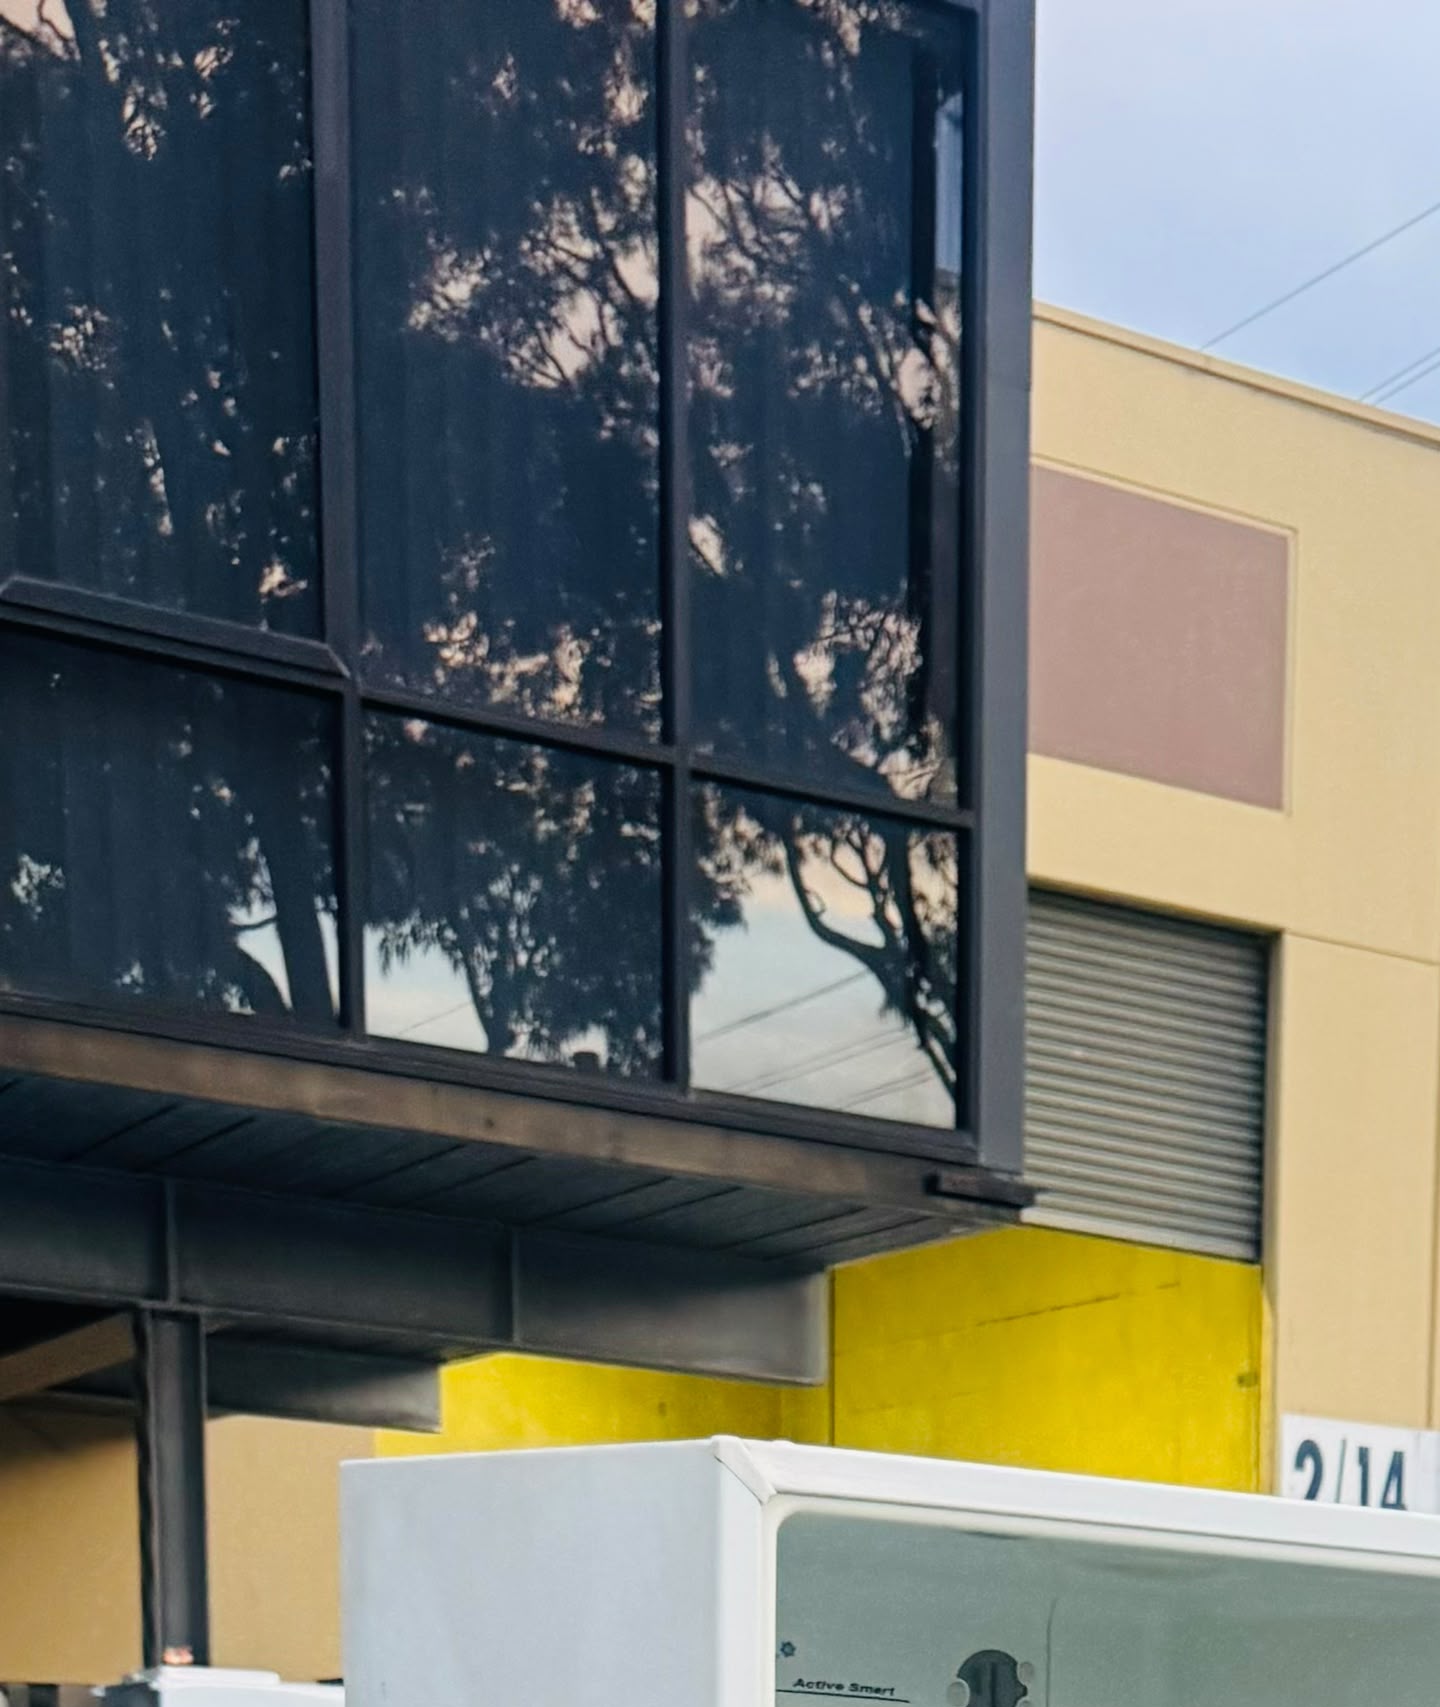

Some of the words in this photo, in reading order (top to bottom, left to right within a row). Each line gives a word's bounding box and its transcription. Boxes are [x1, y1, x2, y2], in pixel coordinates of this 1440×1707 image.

[1294, 1438, 1407, 1511] 2/14
[792, 1677, 845, 1691] Active
[848, 1682, 895, 1696] Smart
